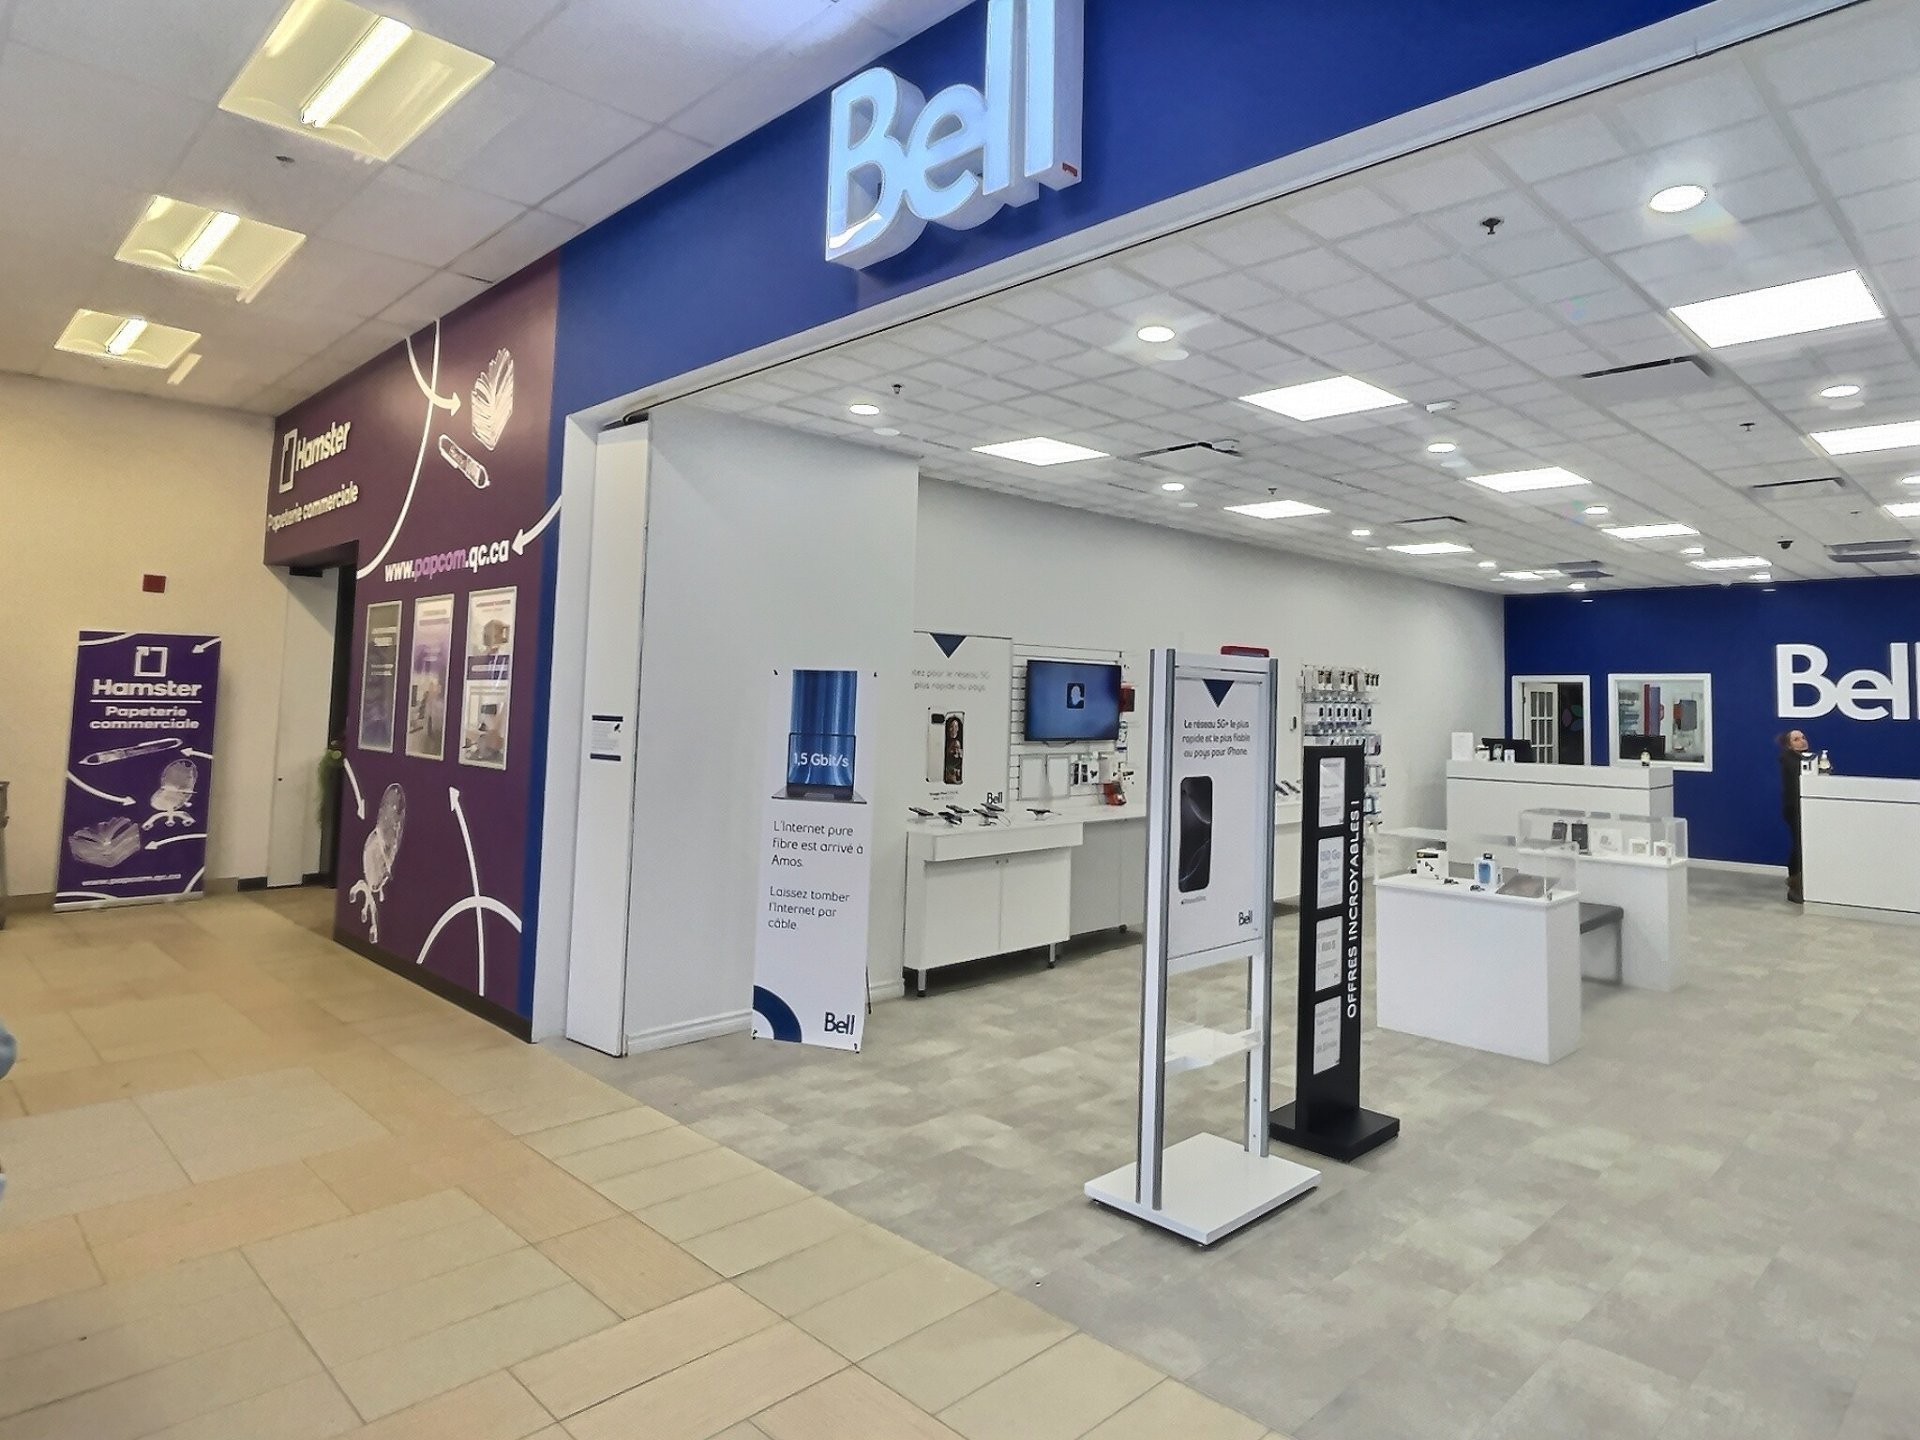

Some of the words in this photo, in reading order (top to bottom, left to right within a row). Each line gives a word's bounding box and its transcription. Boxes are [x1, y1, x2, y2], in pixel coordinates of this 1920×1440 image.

[825, 0, 1085, 262] Bell
[296, 421, 351, 472] Hamster
[267, 501, 302, 533] Papeterie
[302, 480, 359, 520] commerciale
[384, 539, 510, 583] www.papcom.qc.ca
[92, 678, 202, 697] Hamster
[1776, 642, 1920, 720] Bell
[105, 705, 187, 719] Papeterie
[89, 718, 200, 730] commerciale
[810, 753, 850, 768] Gbit/s
[986, 792, 1003, 805] Bell
[773, 820, 826, 836] L'Internet
[827, 826, 854, 838] pure
[772, 837, 799, 850] fibre
[801, 840, 818, 852] est
[820, 843, 854, 854] arrivé
[1349, 811, 1360, 941] INCROYABLES
[769, 885, 809, 900] Laissez
[810, 891, 851, 903] tomber
[818, 907, 838, 918] par
[1238, 909, 1253, 926] Bell
[1347, 945, 1358, 1018] OFFRES
[824, 1011, 856, 1036] Bell
